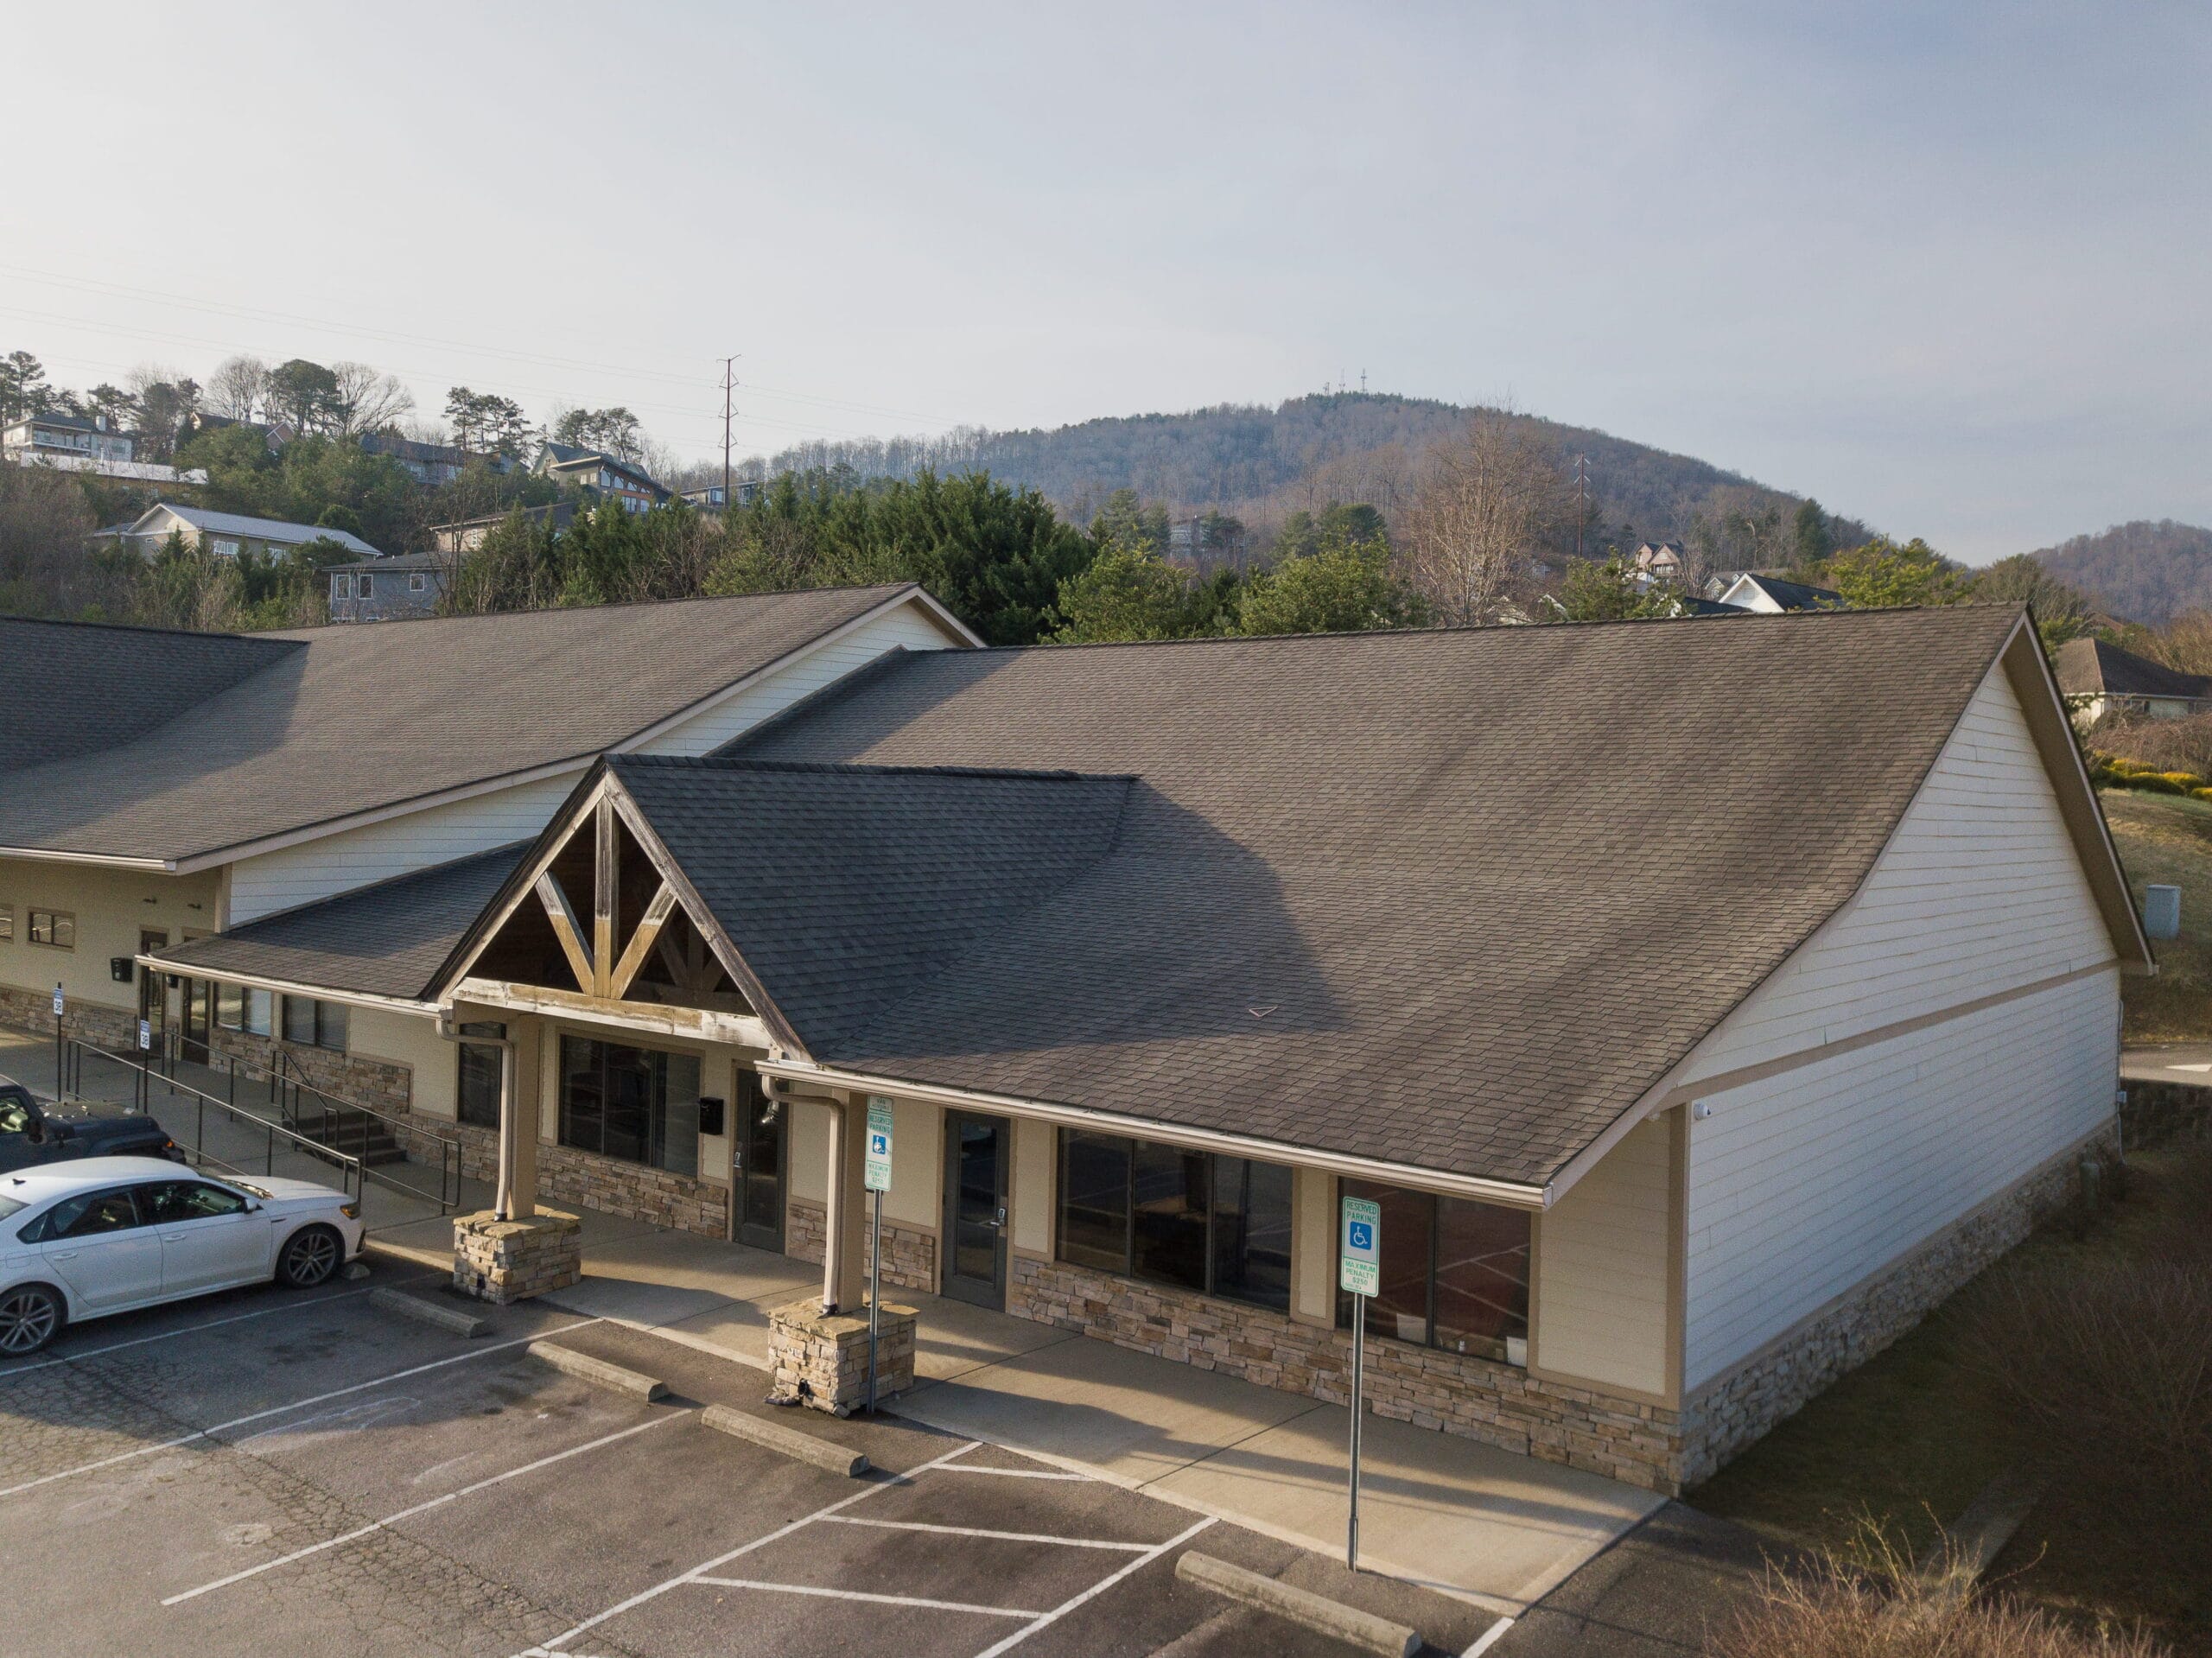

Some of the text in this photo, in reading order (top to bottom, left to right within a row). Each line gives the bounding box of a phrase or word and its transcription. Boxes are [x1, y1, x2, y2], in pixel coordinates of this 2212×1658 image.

[869, 1115, 891, 1127] RESERVED
[870, 1123, 891, 1134] PARKING
[1347, 1201, 1377, 1215] RESERVED
[1347, 1211, 1376, 1225] PARKING
[1345, 1261, 1376, 1274] MAXIMUM
[1345, 1268, 1375, 1280] PENALTY
[1352, 1277, 1369, 1286] $250
